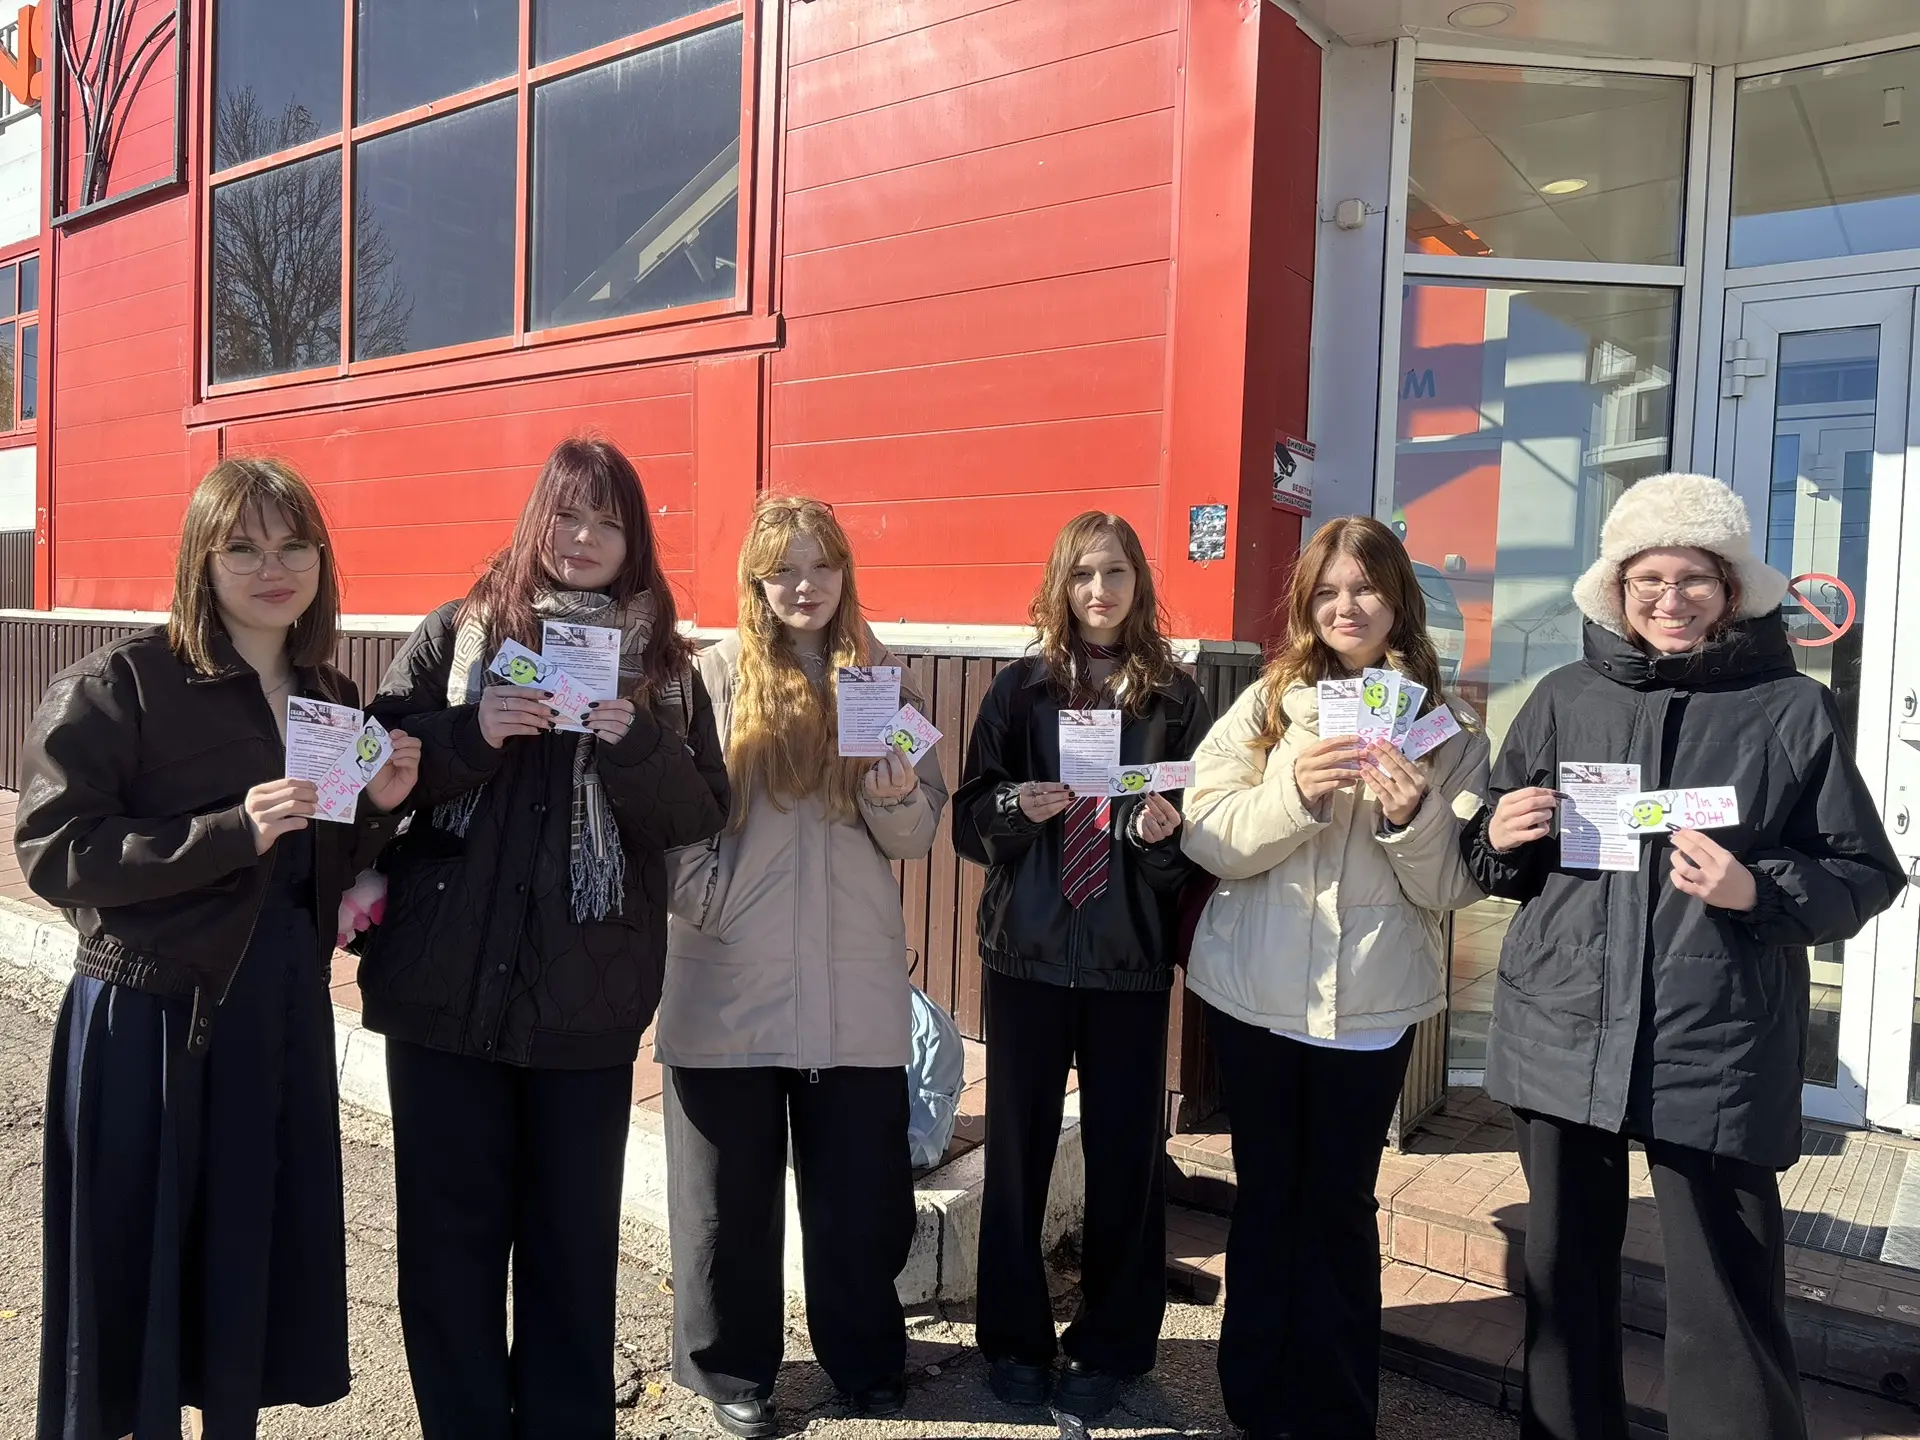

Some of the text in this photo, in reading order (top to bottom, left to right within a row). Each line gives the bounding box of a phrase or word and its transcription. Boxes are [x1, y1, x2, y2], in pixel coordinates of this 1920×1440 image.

[1292, 483, 1312, 496] ВЕДЕТСЯ
[1415, 728, 1447, 752] ЗОЖ
[318, 763, 345, 794] ЗОЖ
[1159, 774, 1187, 788] ЗОЖ
[1685, 791, 1712, 809] Мы
[1684, 811, 1725, 828] ЗОЖ
